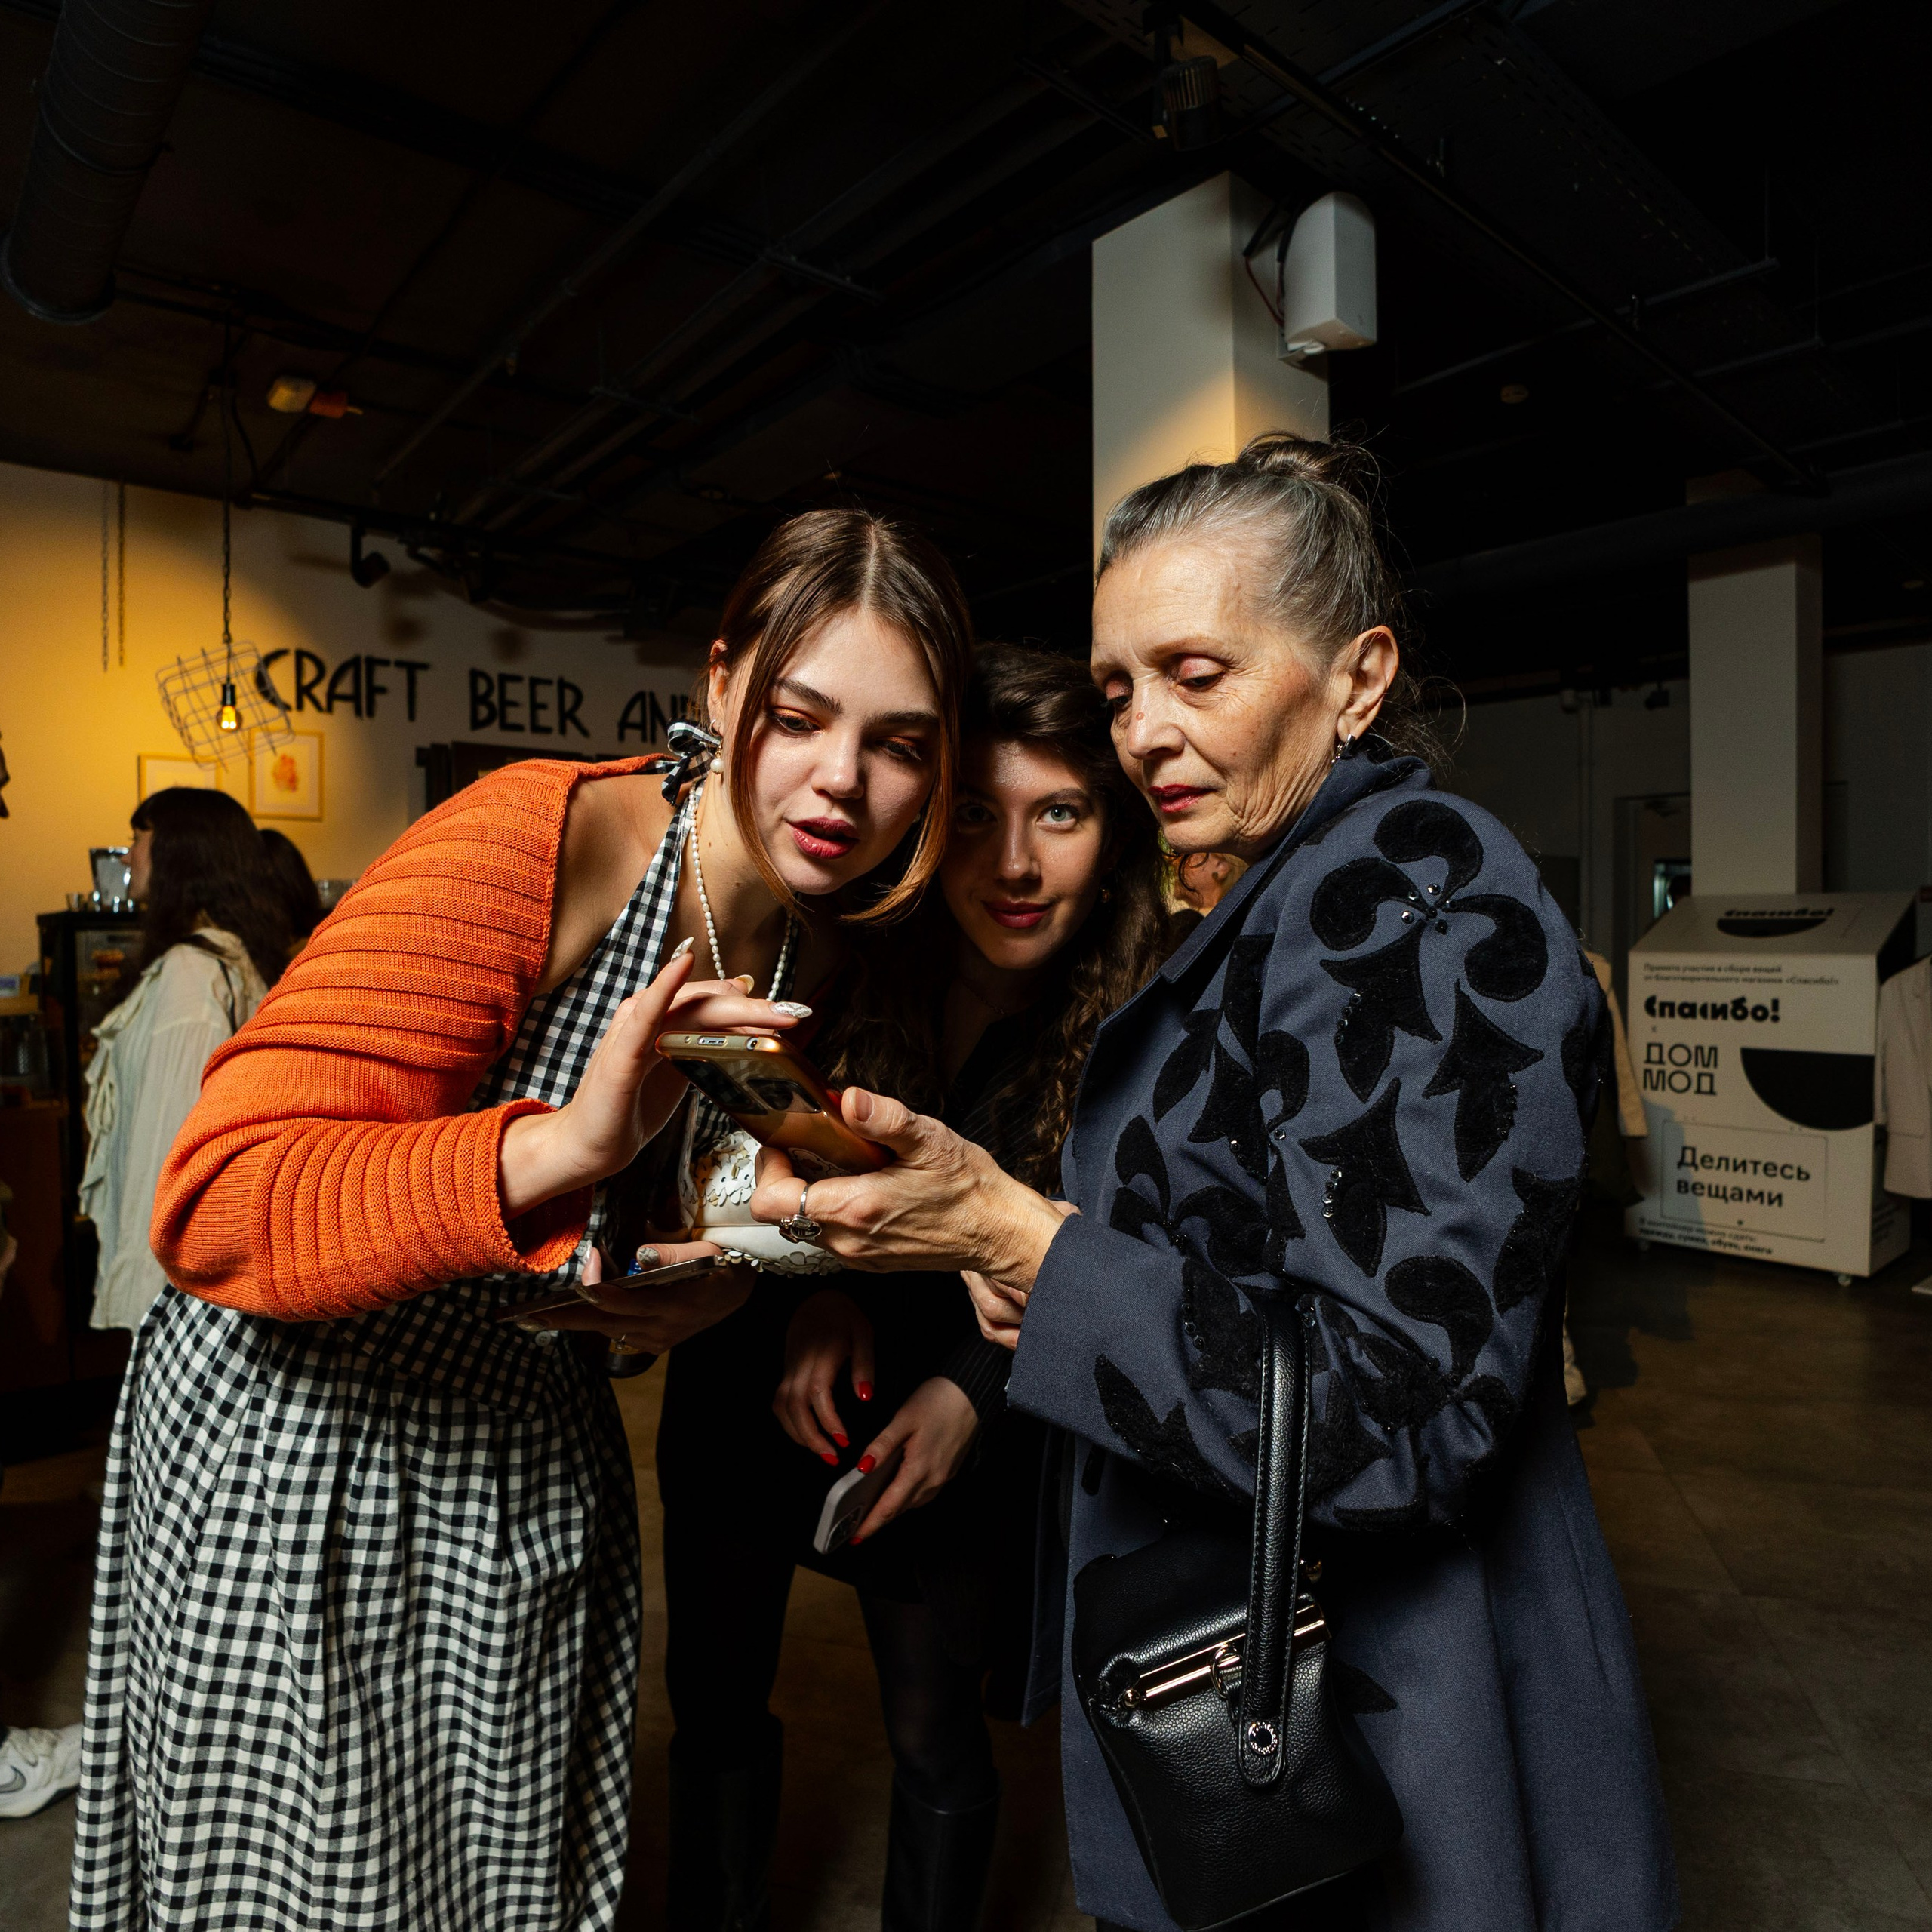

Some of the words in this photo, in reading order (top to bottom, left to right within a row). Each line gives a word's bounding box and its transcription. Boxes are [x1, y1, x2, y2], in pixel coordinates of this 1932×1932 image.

[254, 648, 431, 722] CRAFT
[469, 668, 590, 739] BEER
[1644, 995, 1780, 1023] Спасибо!
[1644, 1042, 1718, 1069] ДОМ
[1643, 1068, 1717, 1095] МОД
[1676, 1146, 1811, 1183] Делитесь
[1676, 1179, 1783, 1208] вещами
